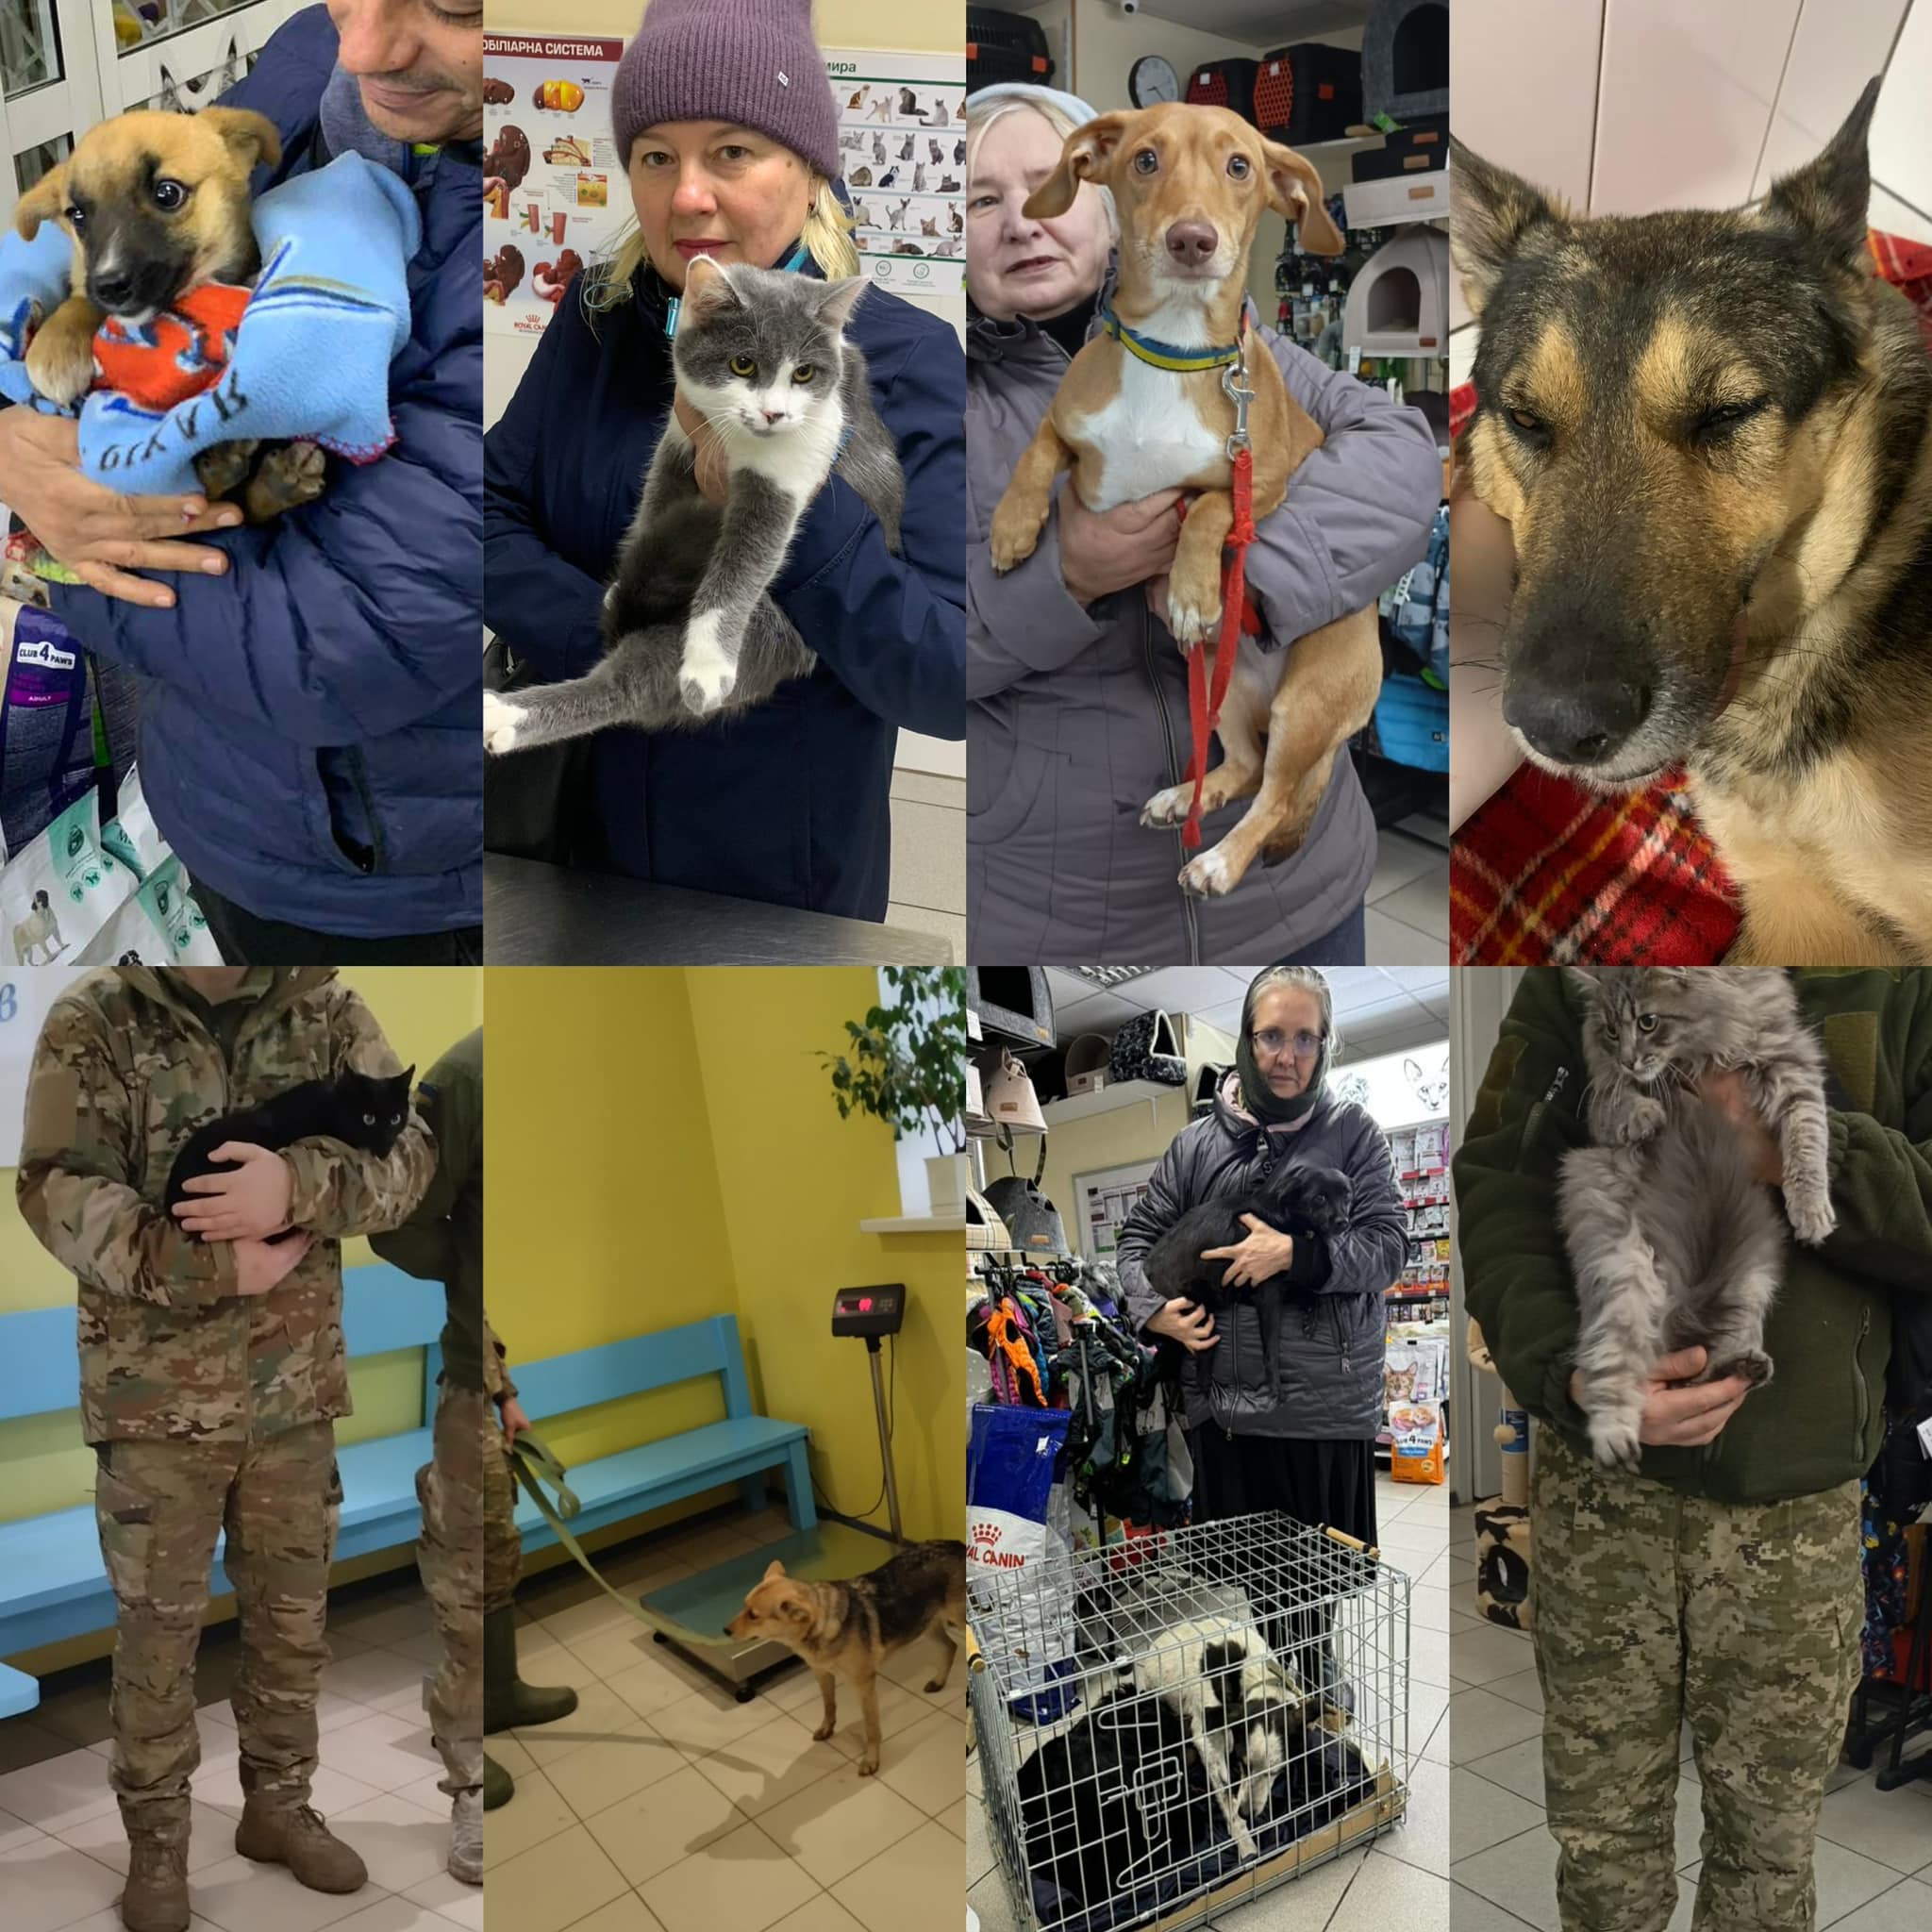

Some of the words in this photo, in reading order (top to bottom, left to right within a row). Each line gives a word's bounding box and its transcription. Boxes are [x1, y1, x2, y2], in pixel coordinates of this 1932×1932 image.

[545, 42, 604, 57] СИСТЕМА
[19, 649, 39, 658] CLUB
[40, 644, 50, 660] 4
[50, 656, 73, 665] PAWS
[982, 1549, 1025, 1568] CANIN
